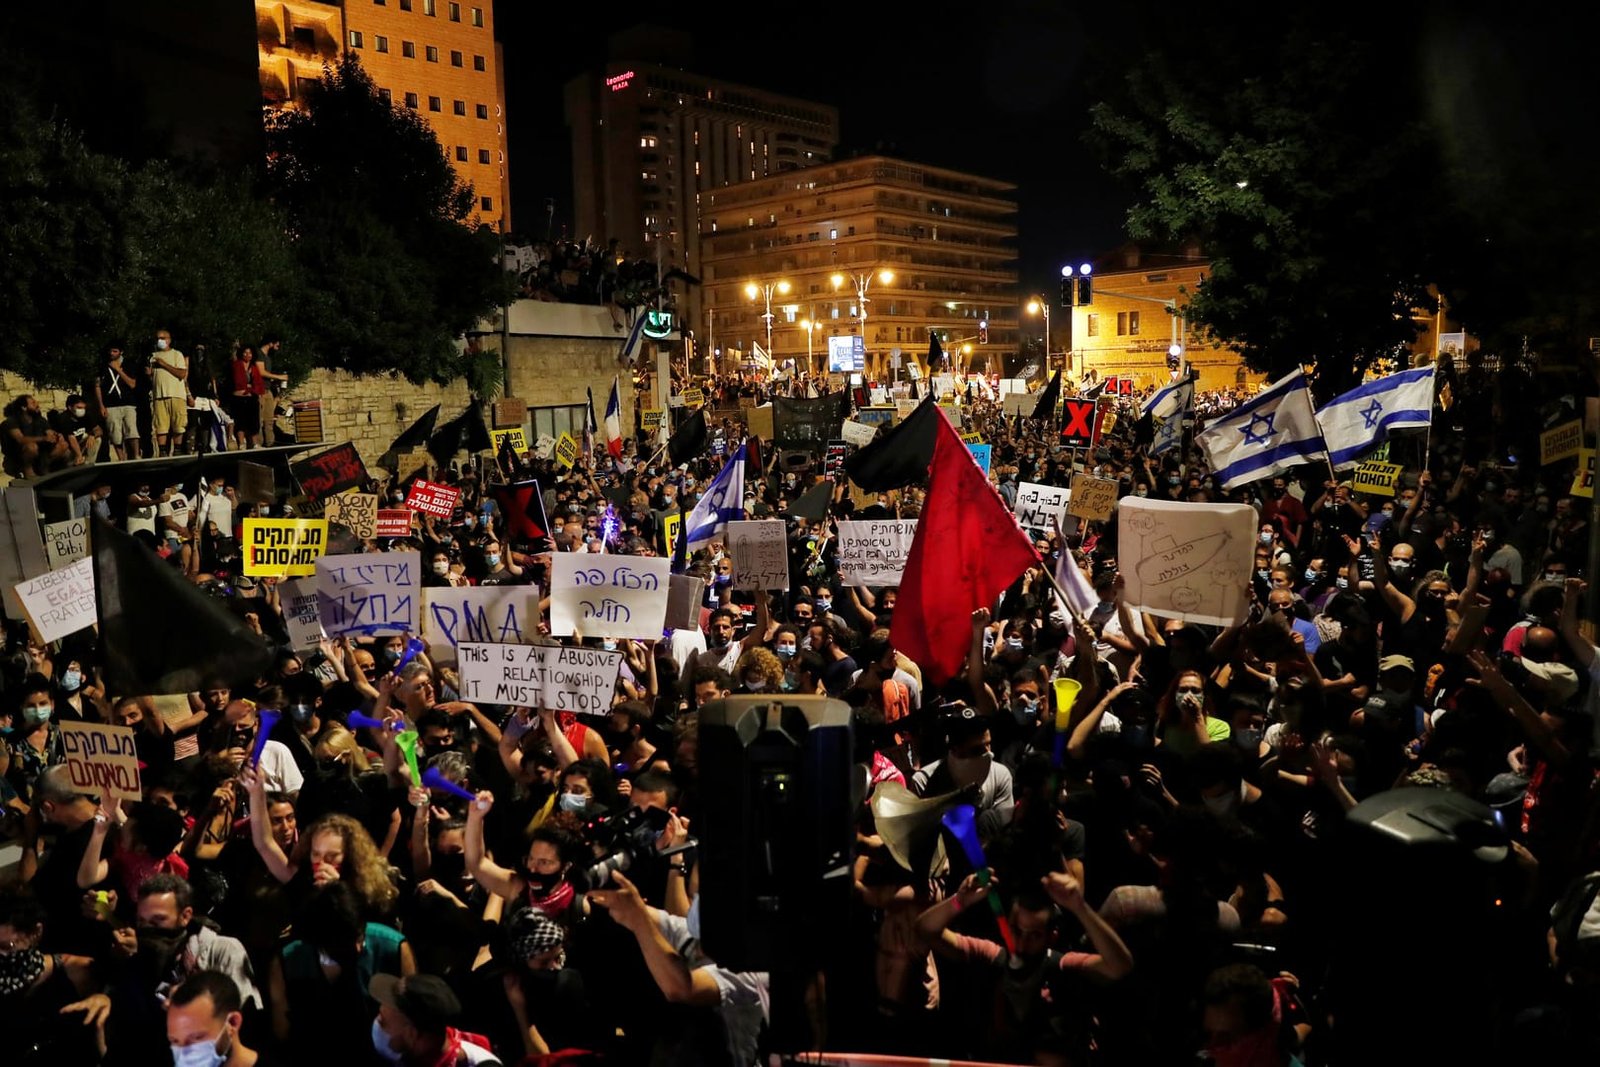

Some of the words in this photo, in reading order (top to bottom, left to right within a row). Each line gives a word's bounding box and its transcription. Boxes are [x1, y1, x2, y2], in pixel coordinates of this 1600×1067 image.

[606, 71, 634, 86] Leonardo
[612, 81, 629, 91] PLAZA
[415, 492, 431, 503] נגד
[432, 497, 453, 508] העם
[1020, 491, 1039, 504] כסף
[1041, 494, 1061, 506] כבוד
[408, 498, 450, 516] הממשלה
[253, 527, 321, 546] מנותקים
[56, 541, 83, 556] Bibi
[1162, 544, 1194, 562] המדינה
[327, 561, 412, 590] מדינה
[1158, 564, 1190, 582] צוללת
[579, 598, 631, 623] חולה
[461, 645, 489, 663] THIS
[501, 643, 515, 661] IS
[526, 646, 547, 662] AN
[558, 646, 616, 668] ABUSIVE
[464, 680, 481, 698] IT
[496, 684, 539, 704] MUST
[555, 690, 607, 715] STOP.
[63, 730, 136, 760] מנותקים
[68, 758, 140, 792] נמאסתם
